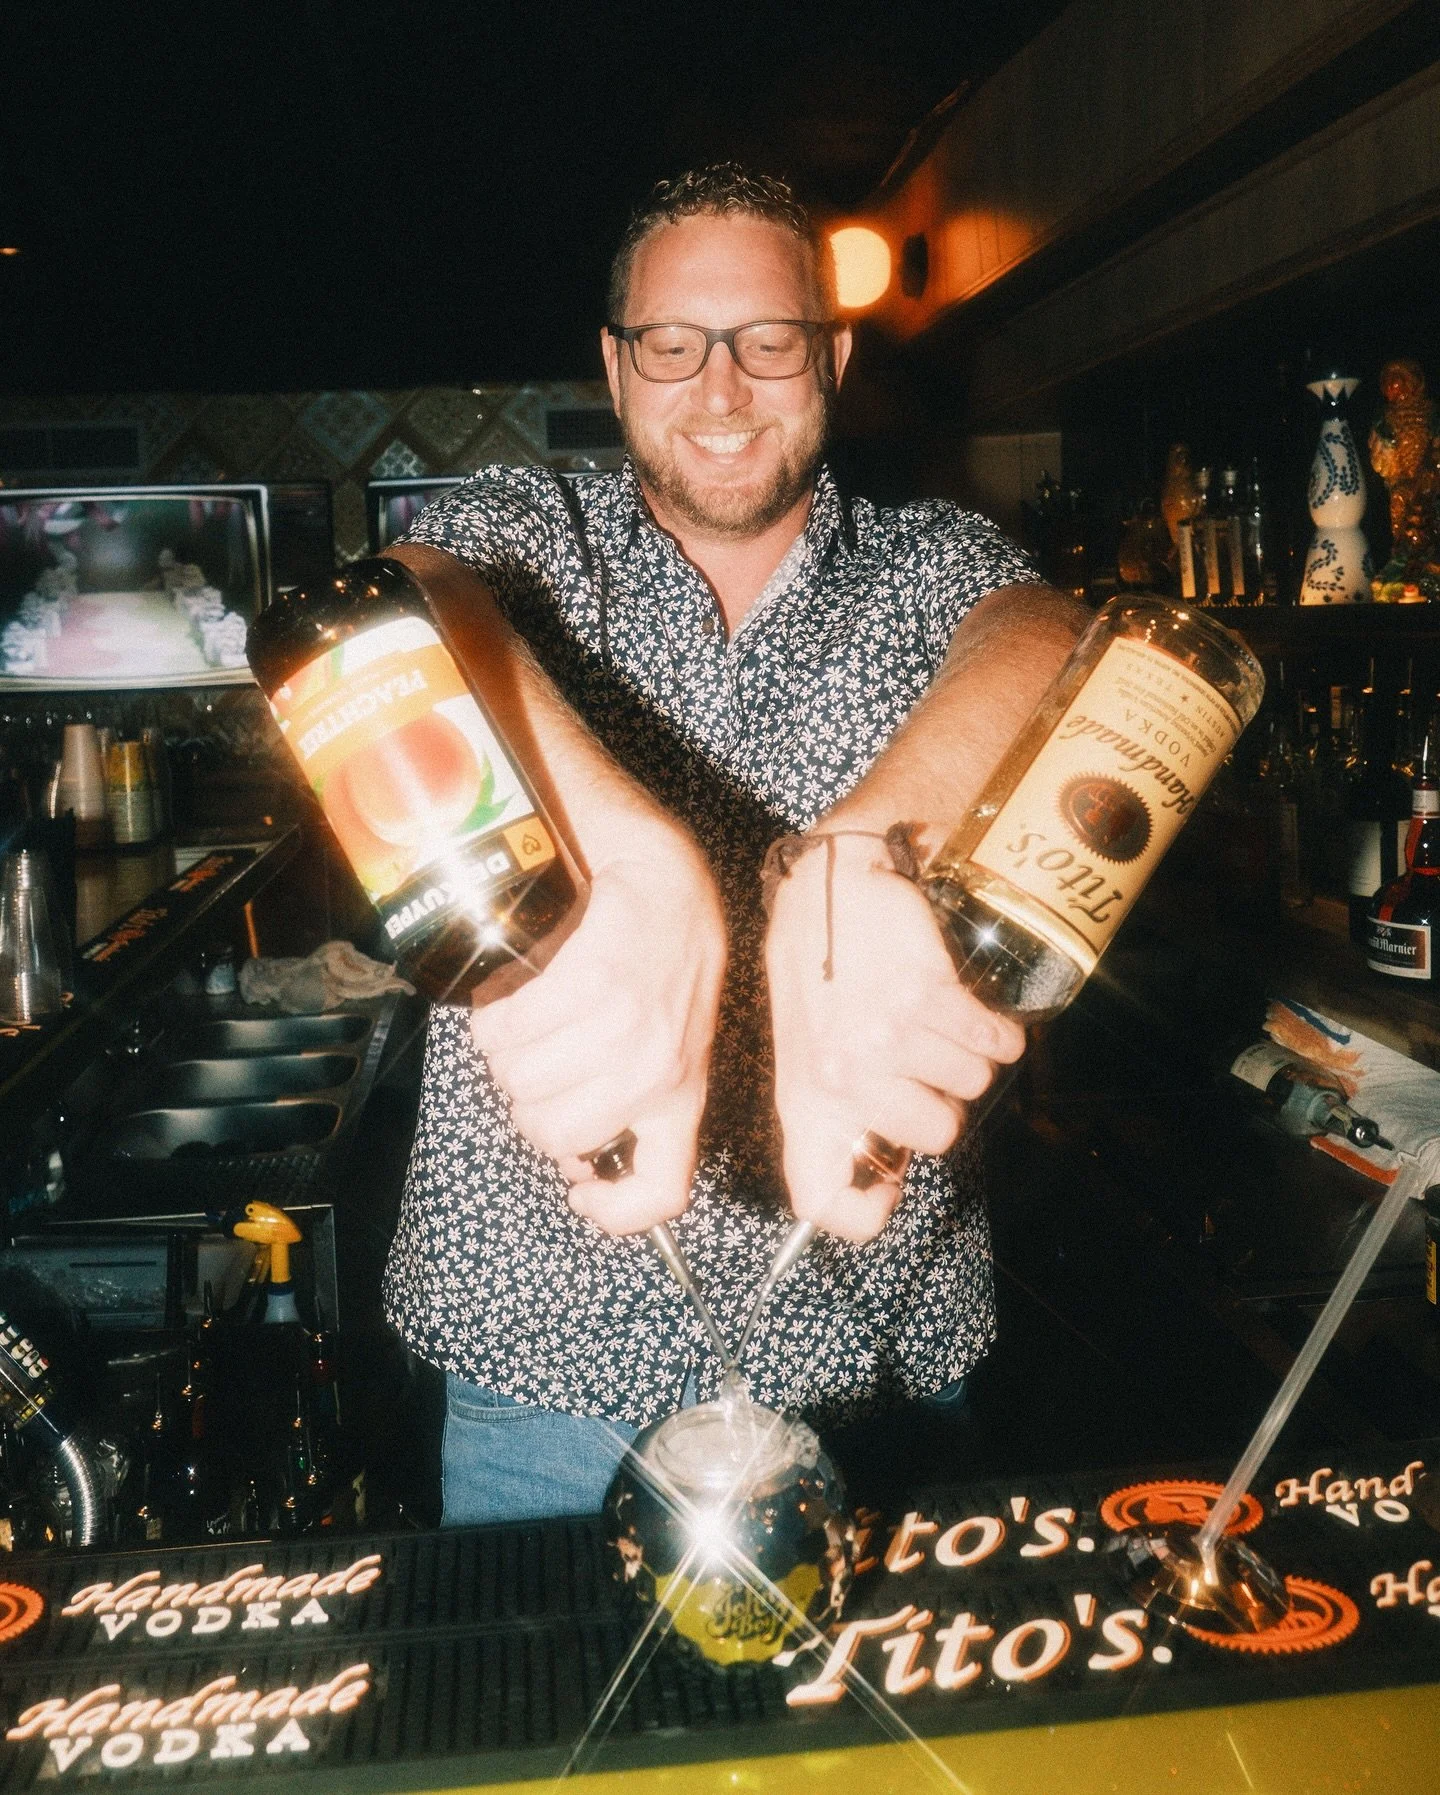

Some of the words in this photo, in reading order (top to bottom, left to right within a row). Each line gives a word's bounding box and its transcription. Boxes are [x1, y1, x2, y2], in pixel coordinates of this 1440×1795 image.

[1058, 714, 1196, 815] Handmade
[1124, 708, 1191, 767] VODKA
[1379, 937, 1417, 956] Marnier
[61, 1554, 382, 1617] Handmade
[100, 1597, 329, 1641] VODKA
[6, 1663, 370, 1741] Handmade
[49, 1717, 311, 1774] VODKA
